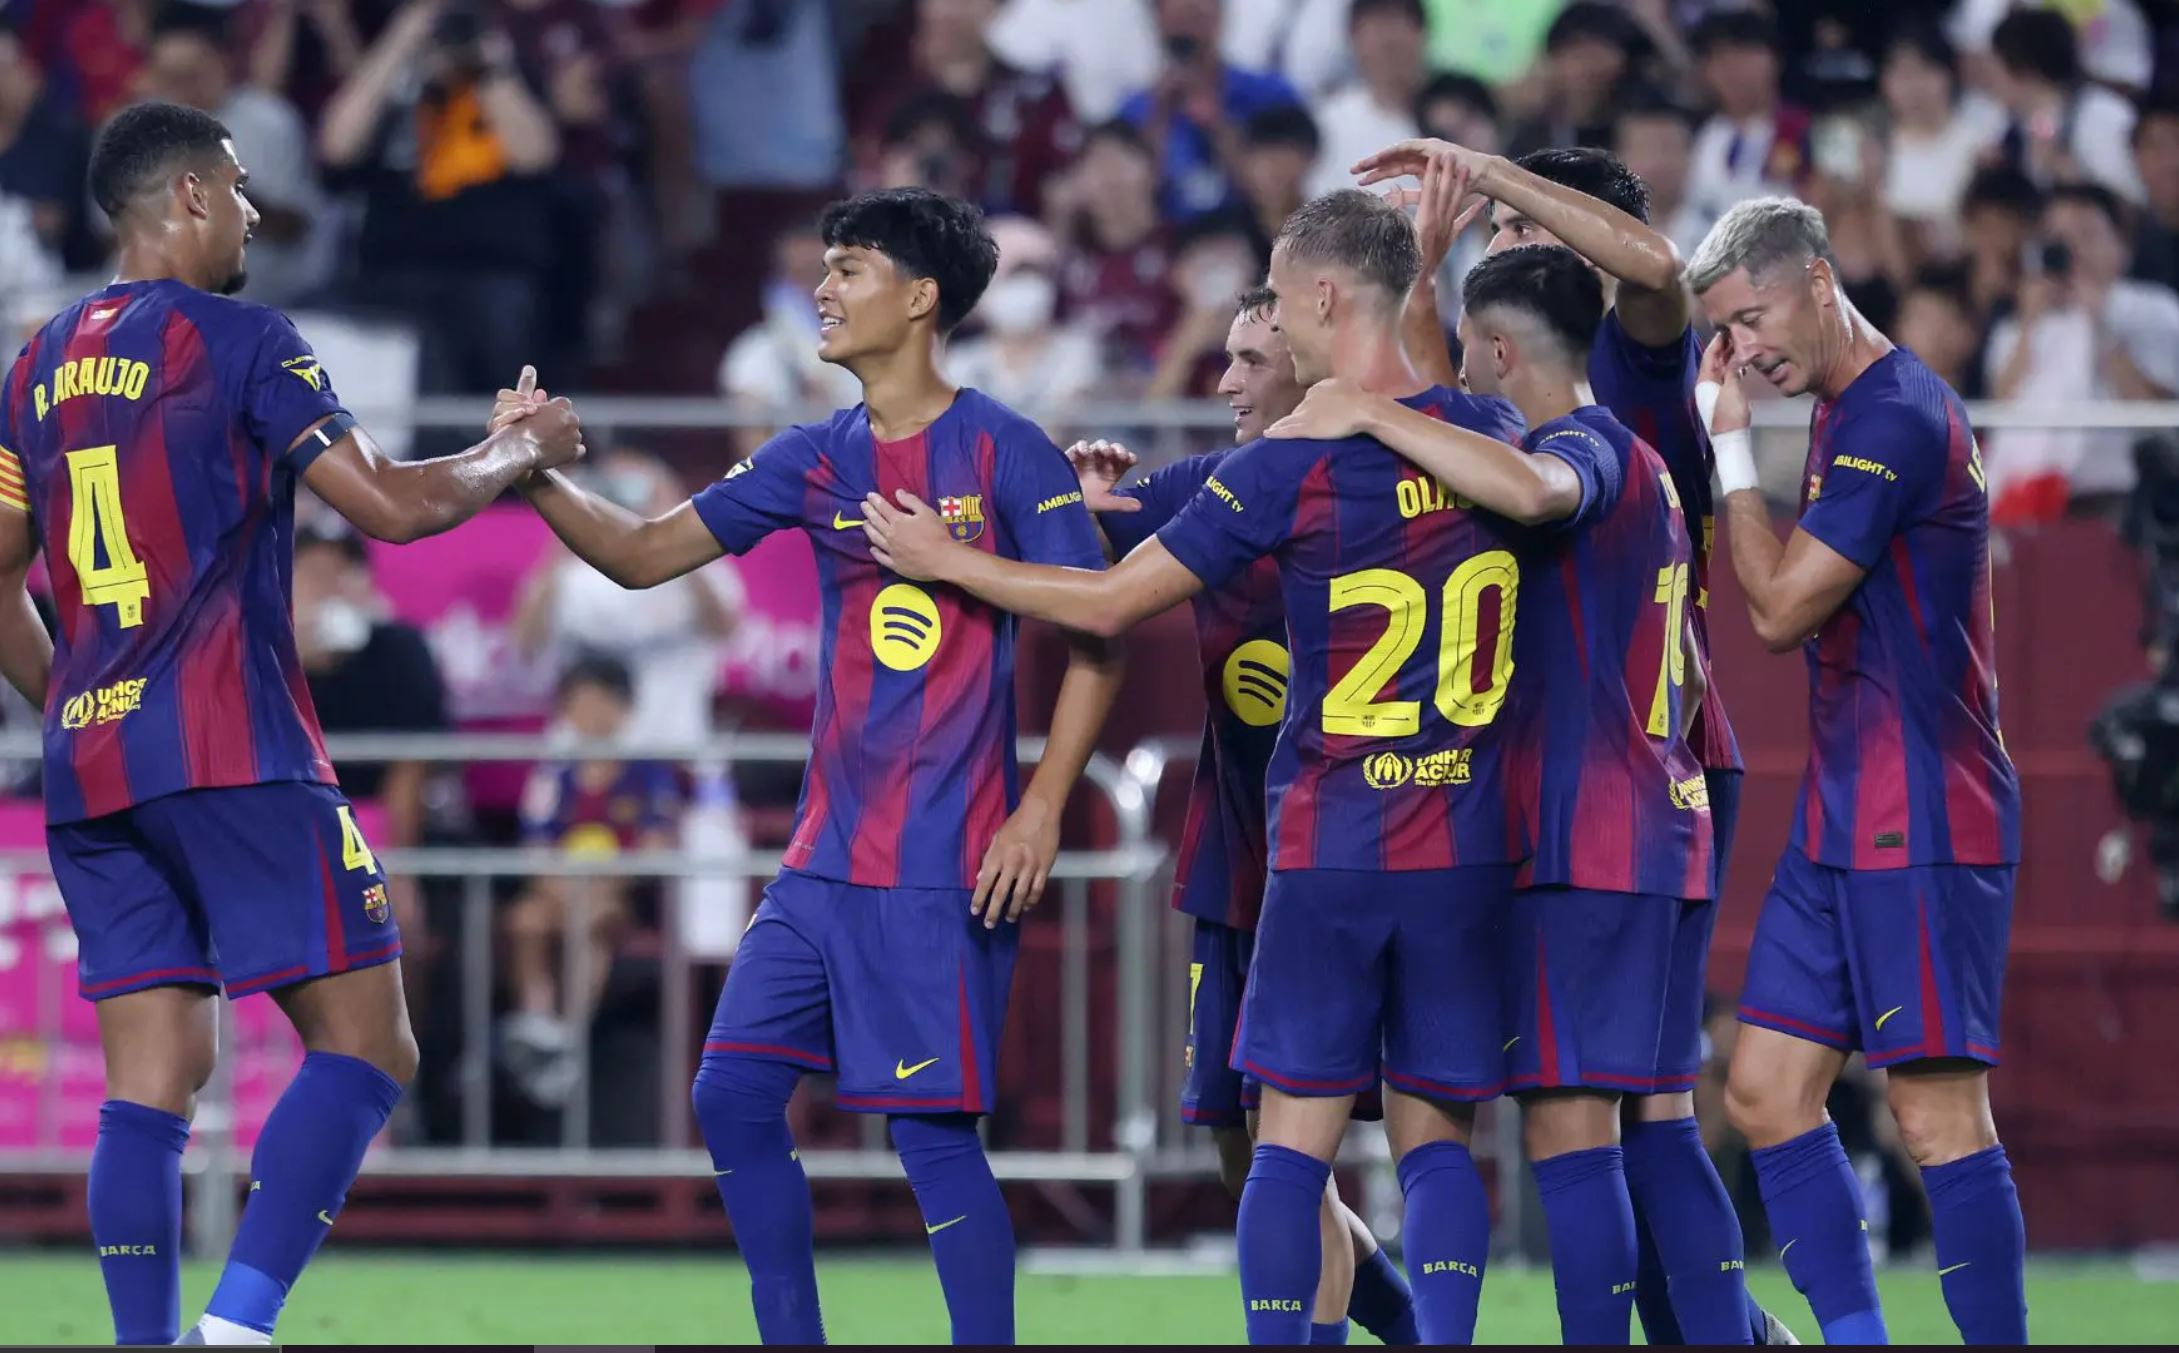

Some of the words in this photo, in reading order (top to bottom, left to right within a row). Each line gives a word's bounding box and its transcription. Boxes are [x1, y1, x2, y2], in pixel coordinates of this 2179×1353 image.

[53, 357, 150, 406] ARAUJO
[65, 444, 151, 629] 4
[1322, 549, 1520, 737] 20
[336, 805, 376, 875] 4
